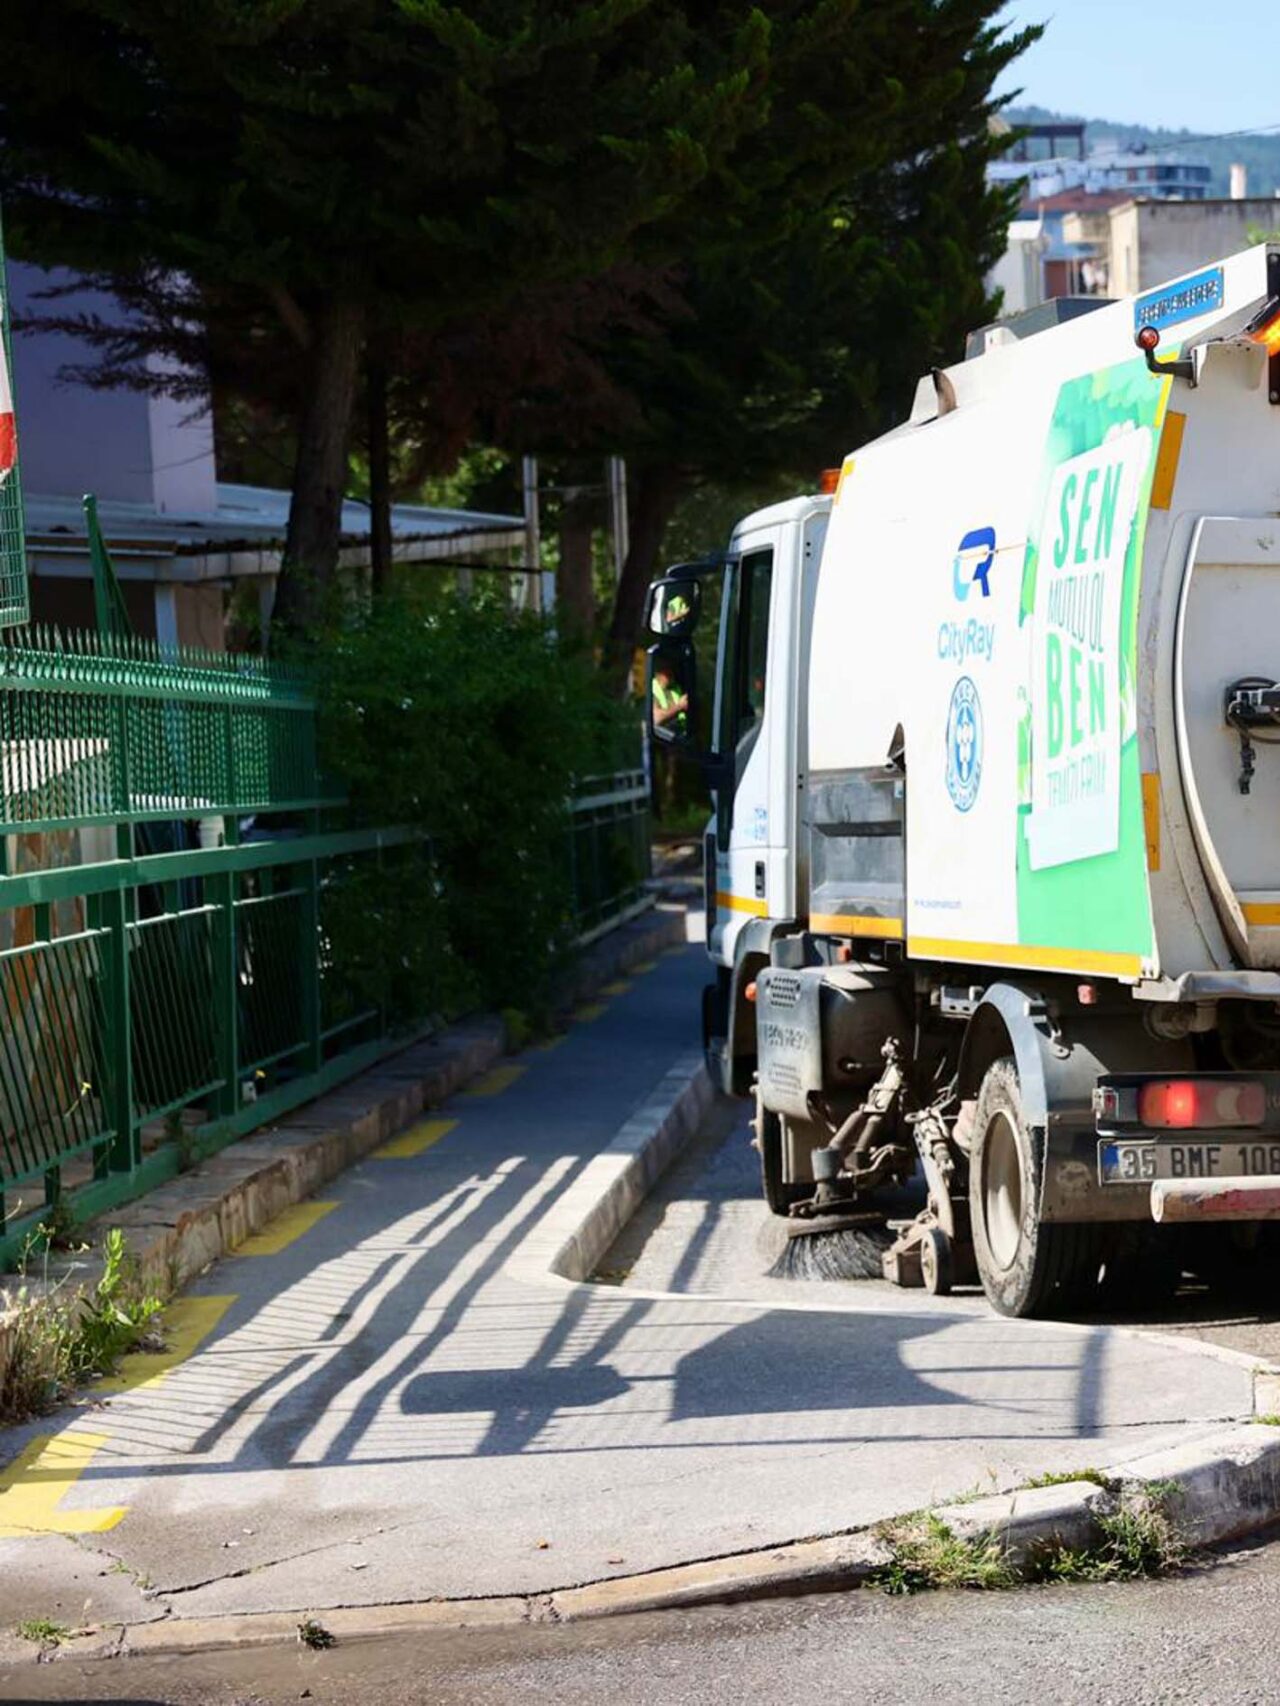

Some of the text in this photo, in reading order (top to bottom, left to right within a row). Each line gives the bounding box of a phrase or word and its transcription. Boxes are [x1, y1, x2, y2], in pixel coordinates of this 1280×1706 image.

[1053, 461, 1124, 569] SEN
[937, 617, 995, 666] CityRay
[1047, 571, 1106, 654] MUTLU OL
[1046, 630, 1106, 760] BEN
[1122, 1148, 1158, 1180] 35
[1170, 1146, 1221, 1178] BMF
